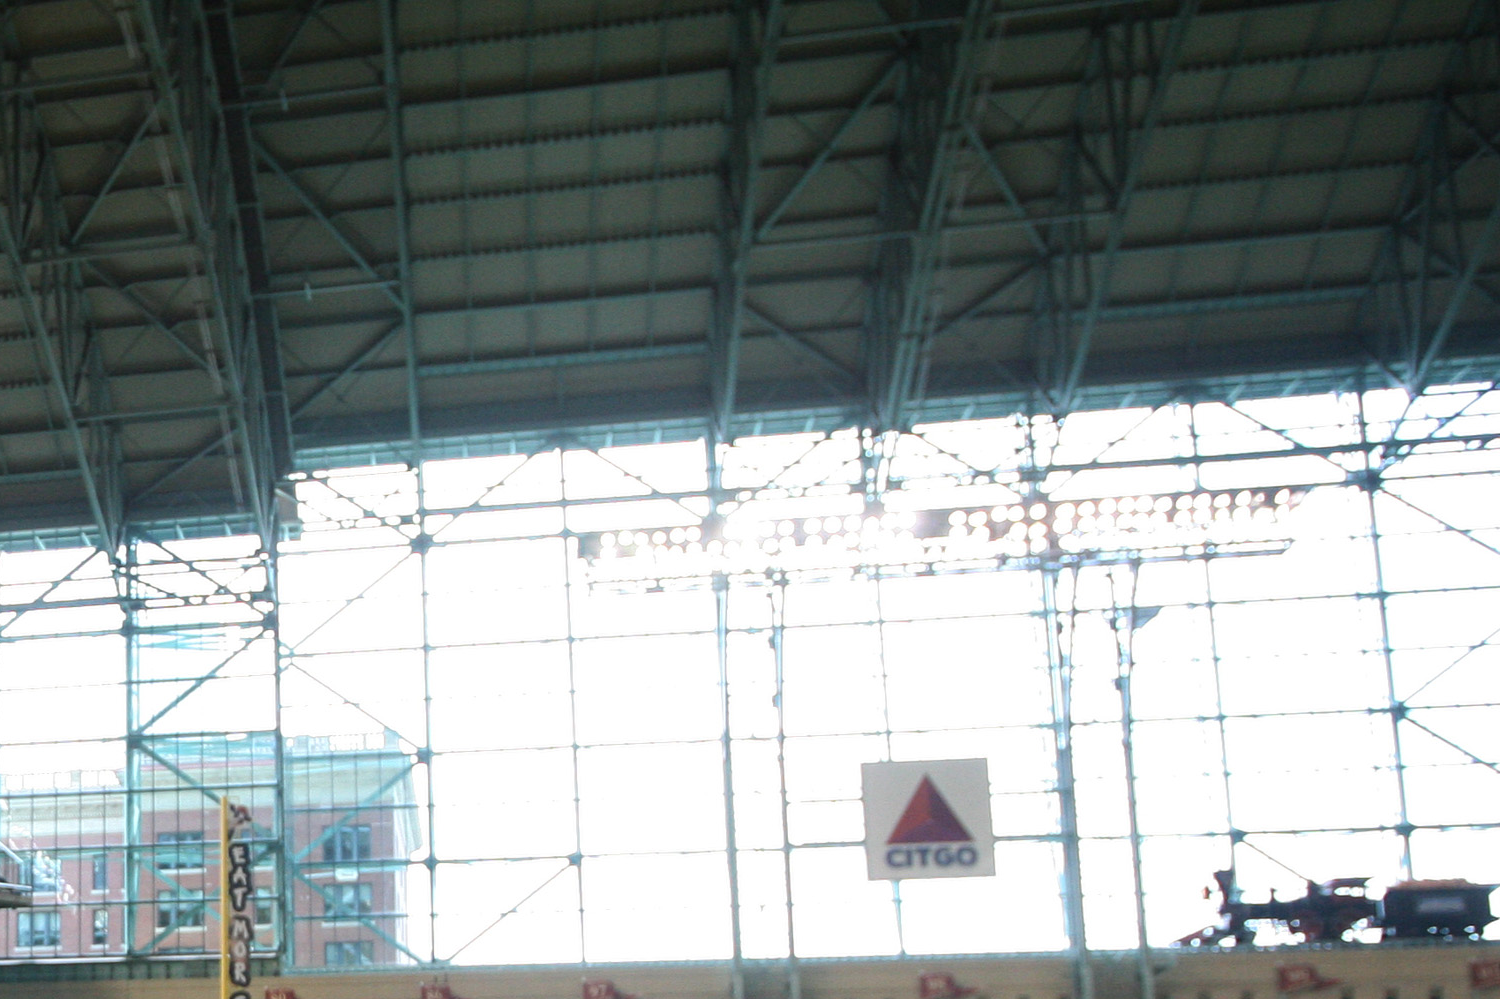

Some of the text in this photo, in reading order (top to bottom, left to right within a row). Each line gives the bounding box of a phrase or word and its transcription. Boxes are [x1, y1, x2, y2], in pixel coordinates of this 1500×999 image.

[232, 845, 249, 908] EAT
[886, 846, 978, 868] CITGO
[232, 918, 250, 984] MOR
